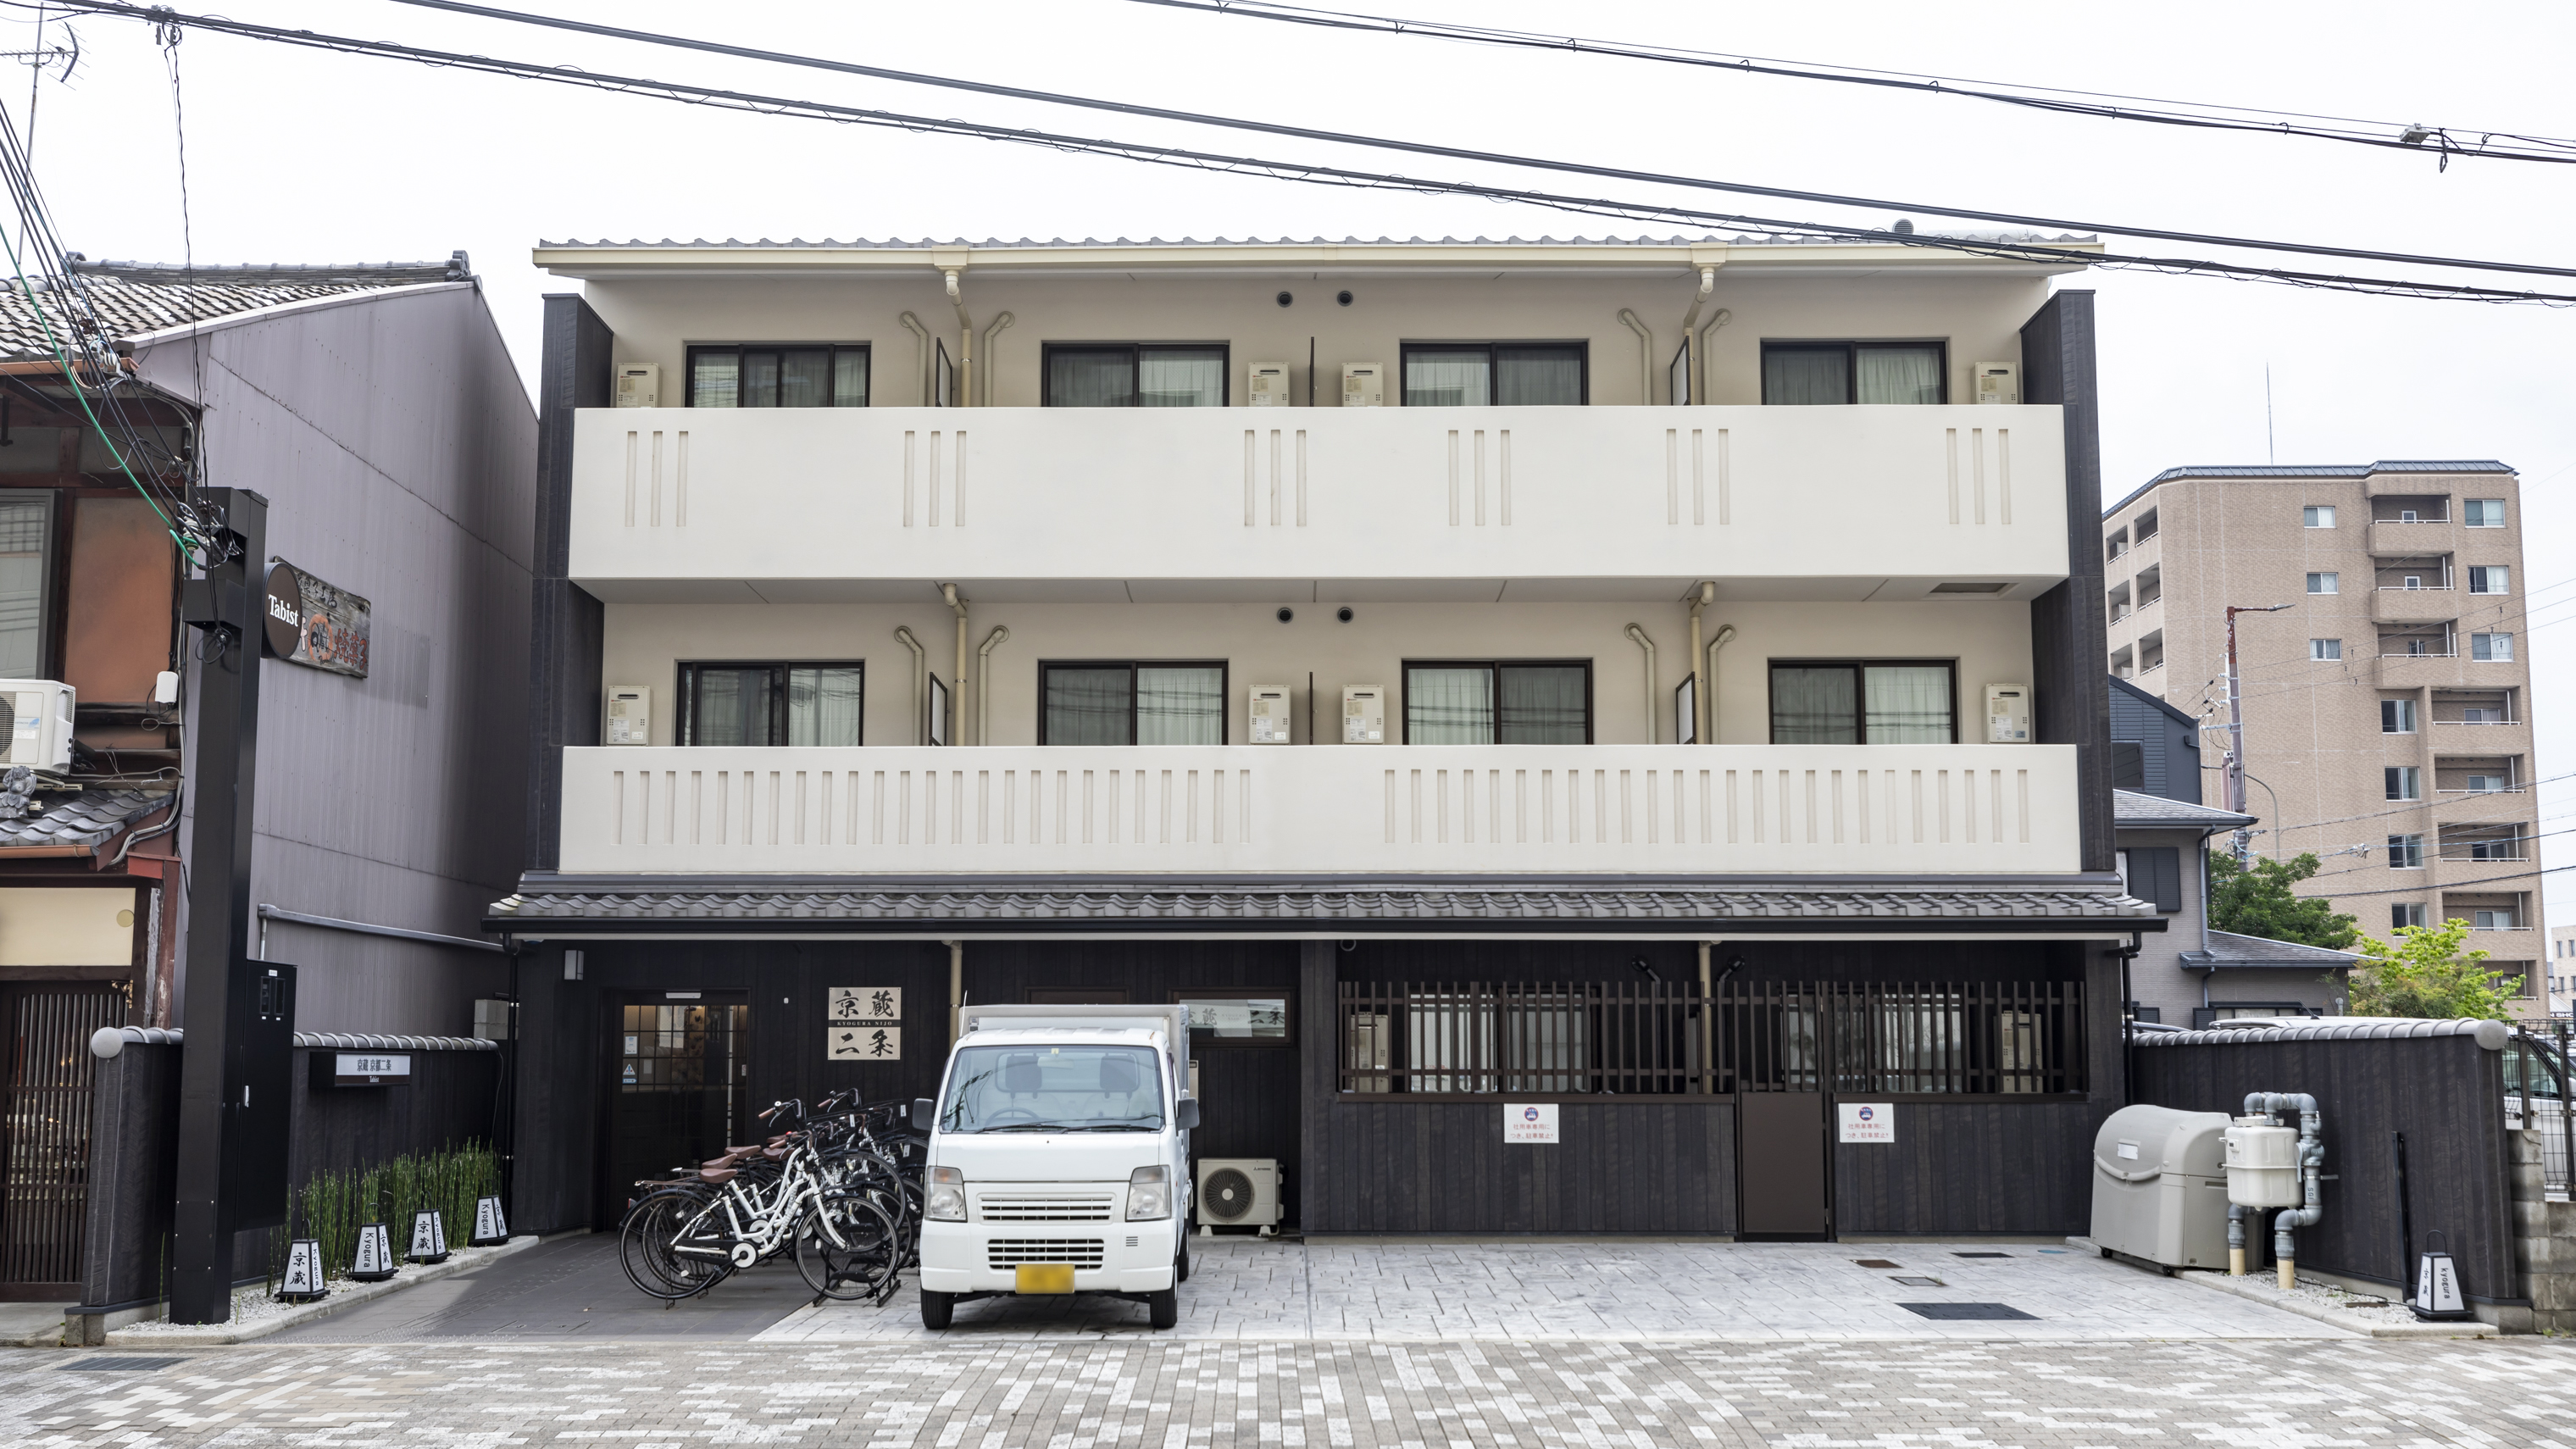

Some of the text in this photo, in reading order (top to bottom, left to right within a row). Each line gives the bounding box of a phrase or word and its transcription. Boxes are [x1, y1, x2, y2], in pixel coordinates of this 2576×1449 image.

[269, 594, 298, 627] Tabist
[836, 990, 894, 1019] 京蔵
[836, 1029, 893, 1058] 二条
[357, 1058, 391, 1072] 京蔵 京都二条
[481, 1204, 491, 1235] Kyogura
[363, 1232, 374, 1268] Kyogura
[416, 1221, 430, 1250] 京蔵
[290, 1252, 307, 1285] 京蔵
